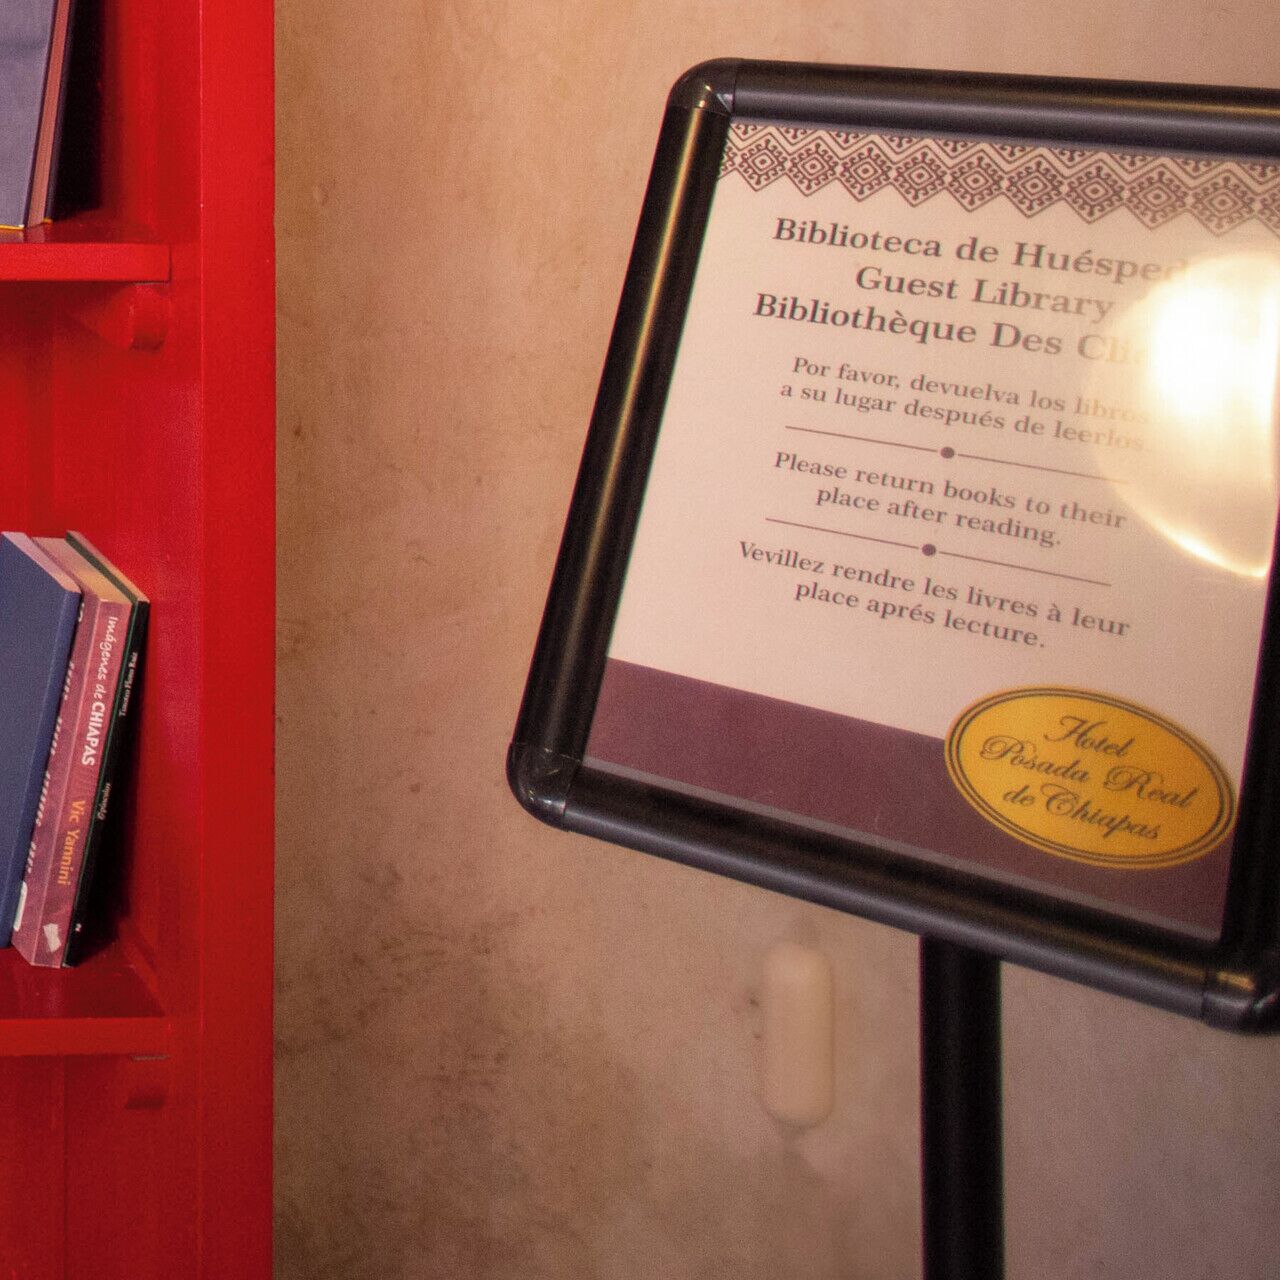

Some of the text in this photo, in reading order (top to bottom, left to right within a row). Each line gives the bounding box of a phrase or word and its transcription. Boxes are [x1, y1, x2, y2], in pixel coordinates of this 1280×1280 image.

[772, 217, 1000, 264] Biblioteca de
[752, 292, 1063, 356] Bibliothèque Des
[855, 265, 1116, 325] Guest Library
[780, 383, 1045, 437] a su lugar después de
[792, 355, 831, 378] Por
[839, 363, 901, 389] favor,
[909, 374, 1020, 406] devuelva
[1030, 389, 1066, 413] los
[774, 451, 1128, 530] Please return books to their
[814, 486, 1063, 549] place after reading.
[738, 540, 1132, 638] Vevillez rendre les livres à leur
[794, 580, 1046, 650] place aprés lecture.
[57, 615, 118, 886] Imágenes de CHIAPAS Vic Yannini
[1043, 715, 1136, 758] Hotel
[979, 734, 1200, 810] Posada Real
[1002, 782, 1161, 841] de Chiapas
